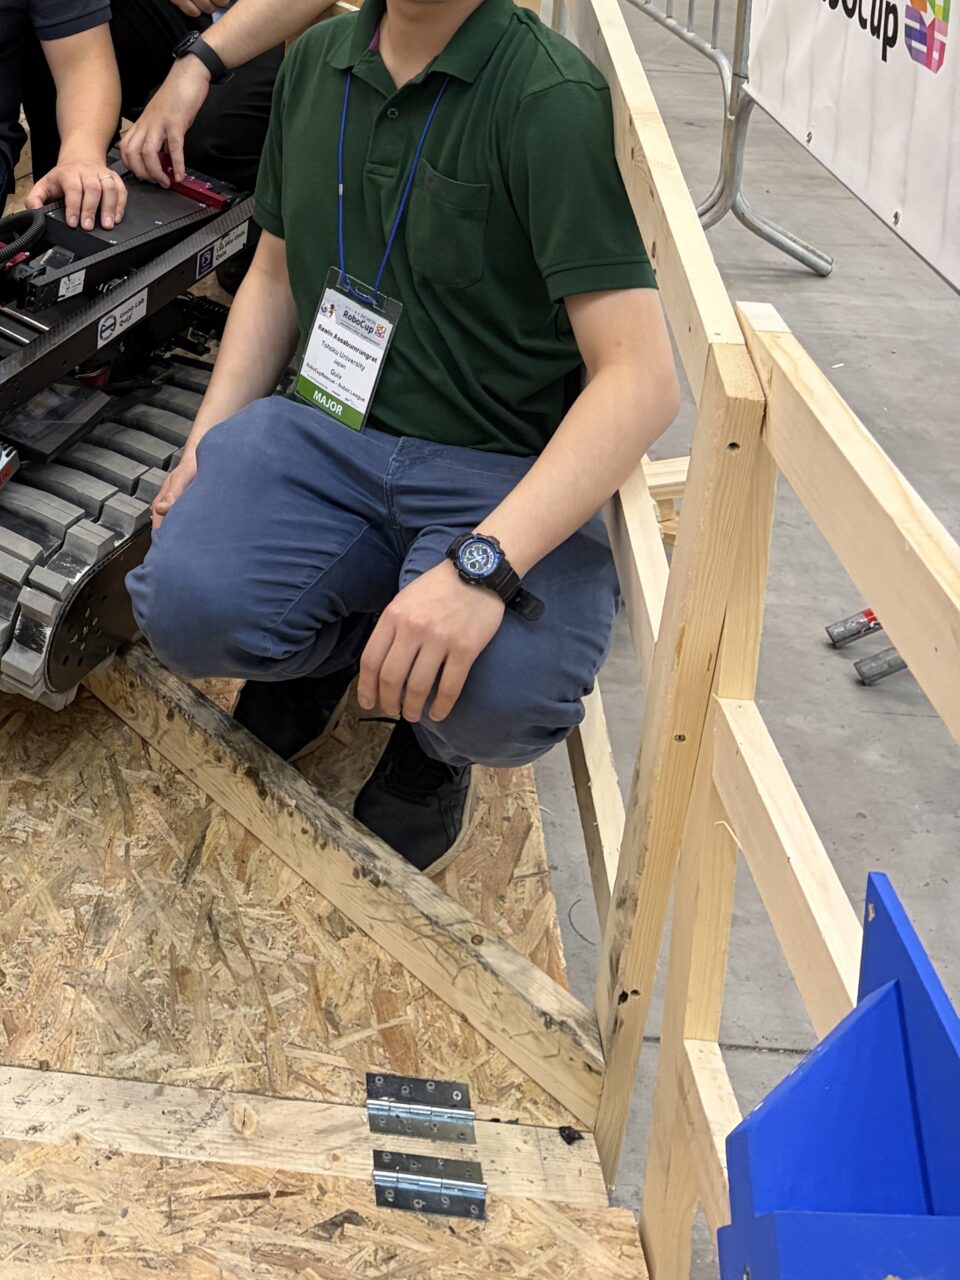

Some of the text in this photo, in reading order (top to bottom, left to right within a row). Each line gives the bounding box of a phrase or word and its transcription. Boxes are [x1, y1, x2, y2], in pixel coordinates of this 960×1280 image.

[343, 310, 374, 334] RoboCup
[321, 340, 366, 372] Tohoku University
[312, 390, 343, 416] MAJOR
